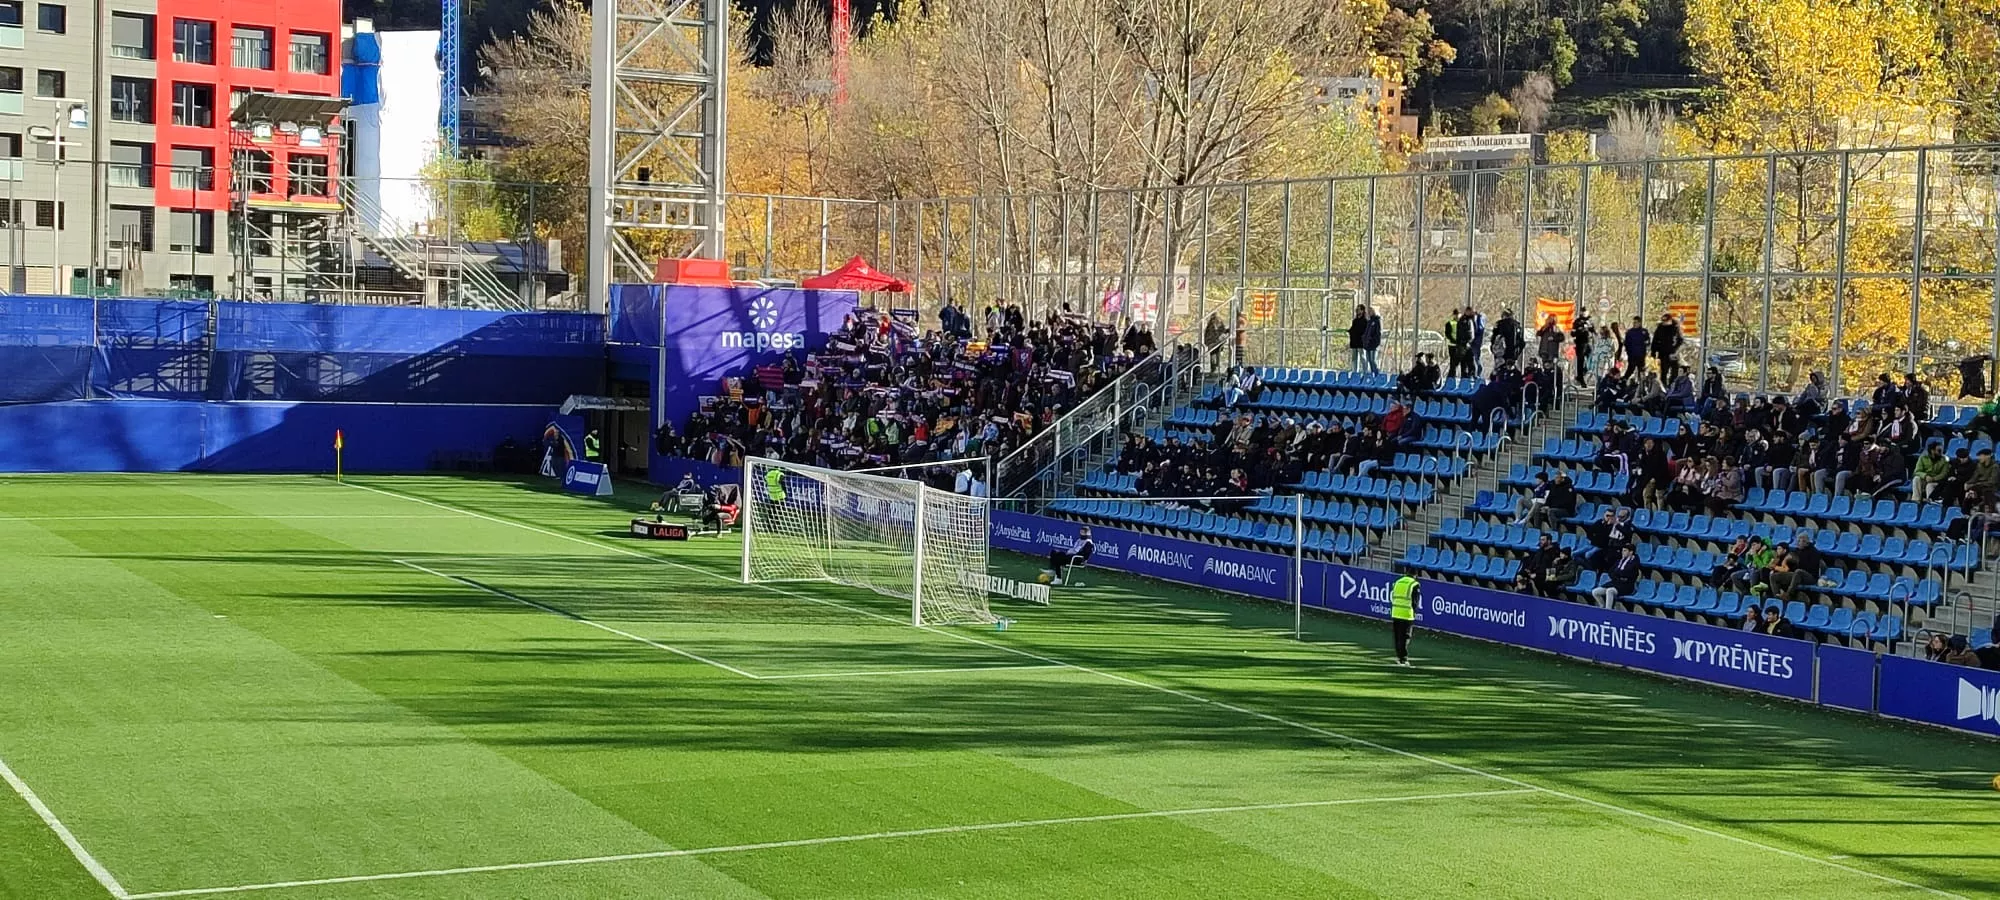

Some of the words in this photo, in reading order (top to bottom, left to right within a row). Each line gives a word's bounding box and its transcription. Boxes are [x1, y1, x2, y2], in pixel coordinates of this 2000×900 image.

[721, 331, 805, 353] mapesa
[653, 526, 685, 538] LALIGA
[1137, 545, 1194, 570] MORABANC
[1214, 559, 1277, 585] MORABANC
[1431, 596, 1526, 628] @andorraworld
